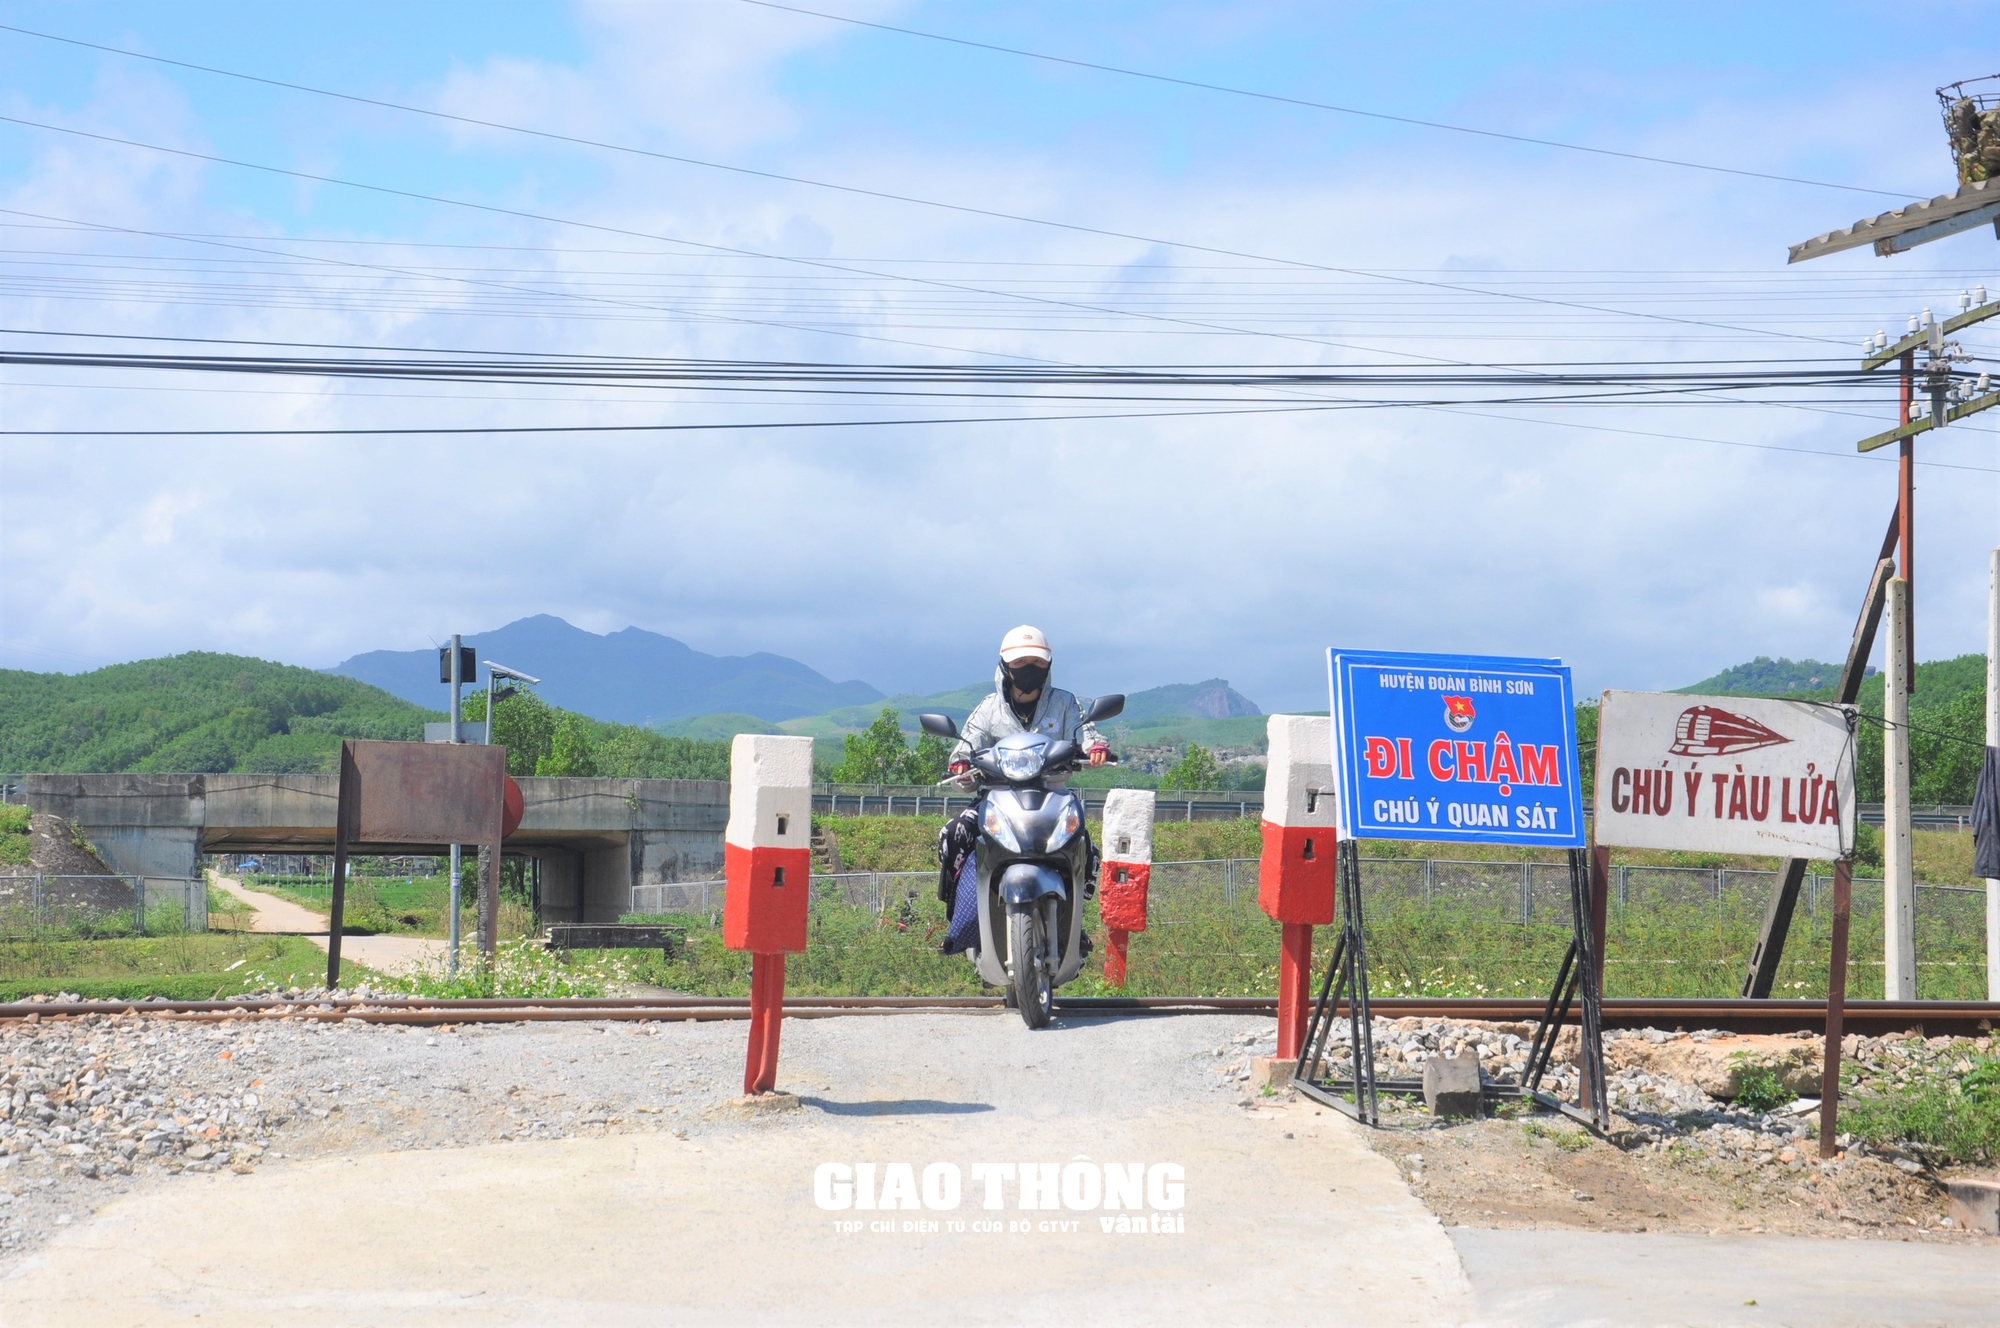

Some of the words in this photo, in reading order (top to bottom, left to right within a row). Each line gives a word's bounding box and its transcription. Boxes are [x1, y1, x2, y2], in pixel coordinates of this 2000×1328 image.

[1379, 672, 1425, 692] HUYỆN
[1428, 674, 1465, 692] ĐOÀN
[1469, 675, 1502, 694] BÌNH
[1506, 679, 1534, 695] SƠN
[1364, 736, 1415, 780] ĐI
[1427, 731, 1562, 797] CHẬM
[1373, 796, 1420, 824] CHÚ
[1426, 797, 1440, 824] Ý
[1447, 802, 1509, 828] QUAN
[1515, 801, 1558, 830] SÁT
[1611, 760, 1674, 817] CHÚ
[1684, 761, 1703, 817] Ý
[1712, 764, 1771, 822] TÀU
[1781, 762, 1839, 826] LỬA
